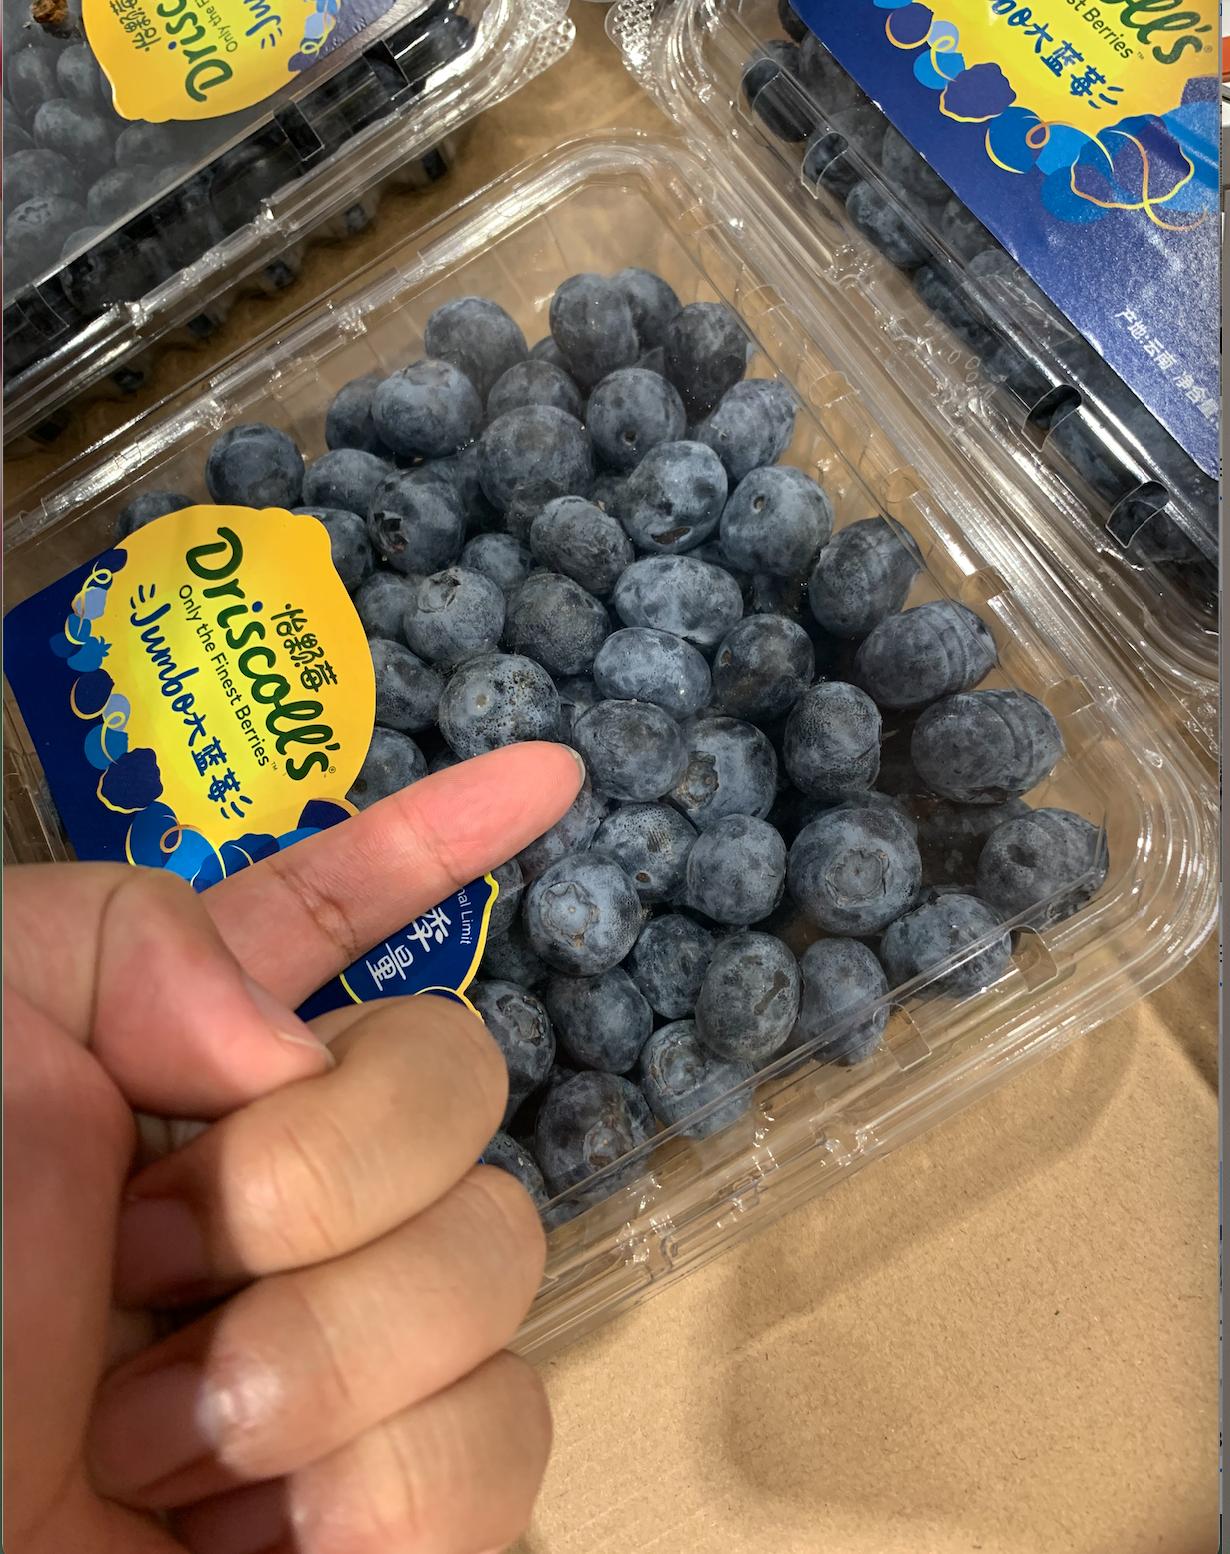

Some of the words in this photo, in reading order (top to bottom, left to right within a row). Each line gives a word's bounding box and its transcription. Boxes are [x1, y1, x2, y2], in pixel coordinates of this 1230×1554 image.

[206, 5, 224, 28] the
[217, 24, 238, 53] Only
[1082, 7, 1135, 60] Berries
[1105, 0, 1213, 64] ll's
[178, 584, 202, 622] Only
[196, 623, 217, 653] the
[210, 653, 243, 706] Finest
[235, 704, 270, 768] Berries
[185, 526, 341, 782] Driscoll's
[270, 602, 338, 693] 怡颗莓
[459, 909, 473, 946] Limit
